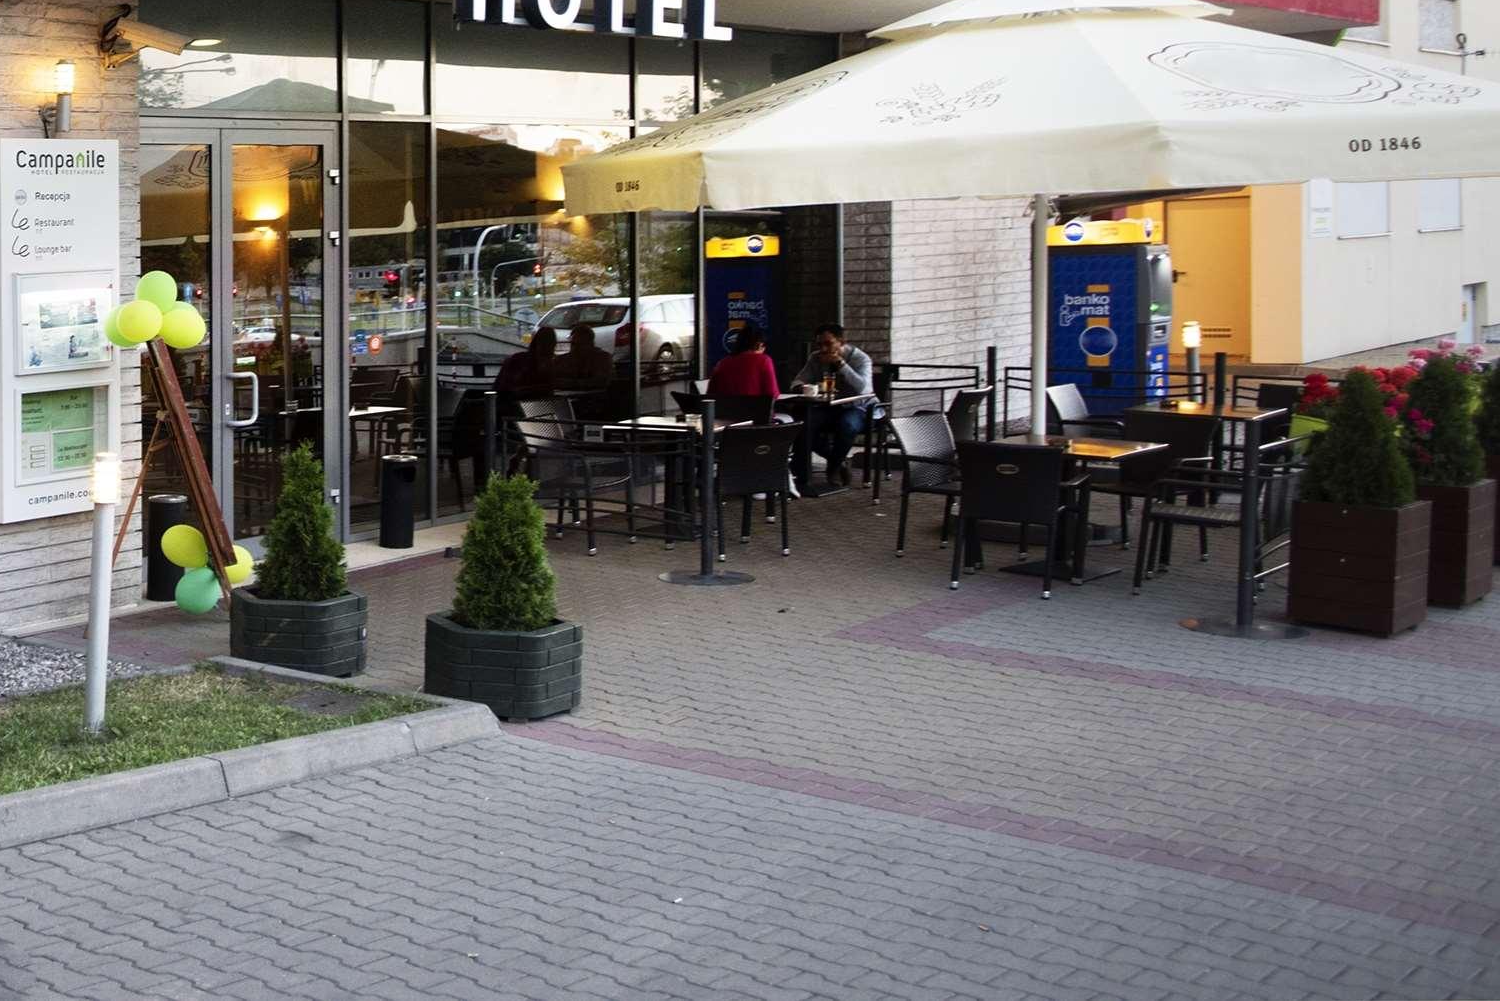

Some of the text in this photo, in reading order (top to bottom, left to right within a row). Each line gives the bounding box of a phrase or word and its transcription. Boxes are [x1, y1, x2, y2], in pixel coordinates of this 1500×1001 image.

[1348, 136, 1421, 153] OD 1846
[16, 150, 105, 175] Campanile
[624, 180, 640, 192] 1846
[34, 191, 71, 202] Recepcja
[34, 218, 75, 227] Restaurant
[1064, 293, 1111, 305] banko
[1080, 304, 1111, 315] mat
